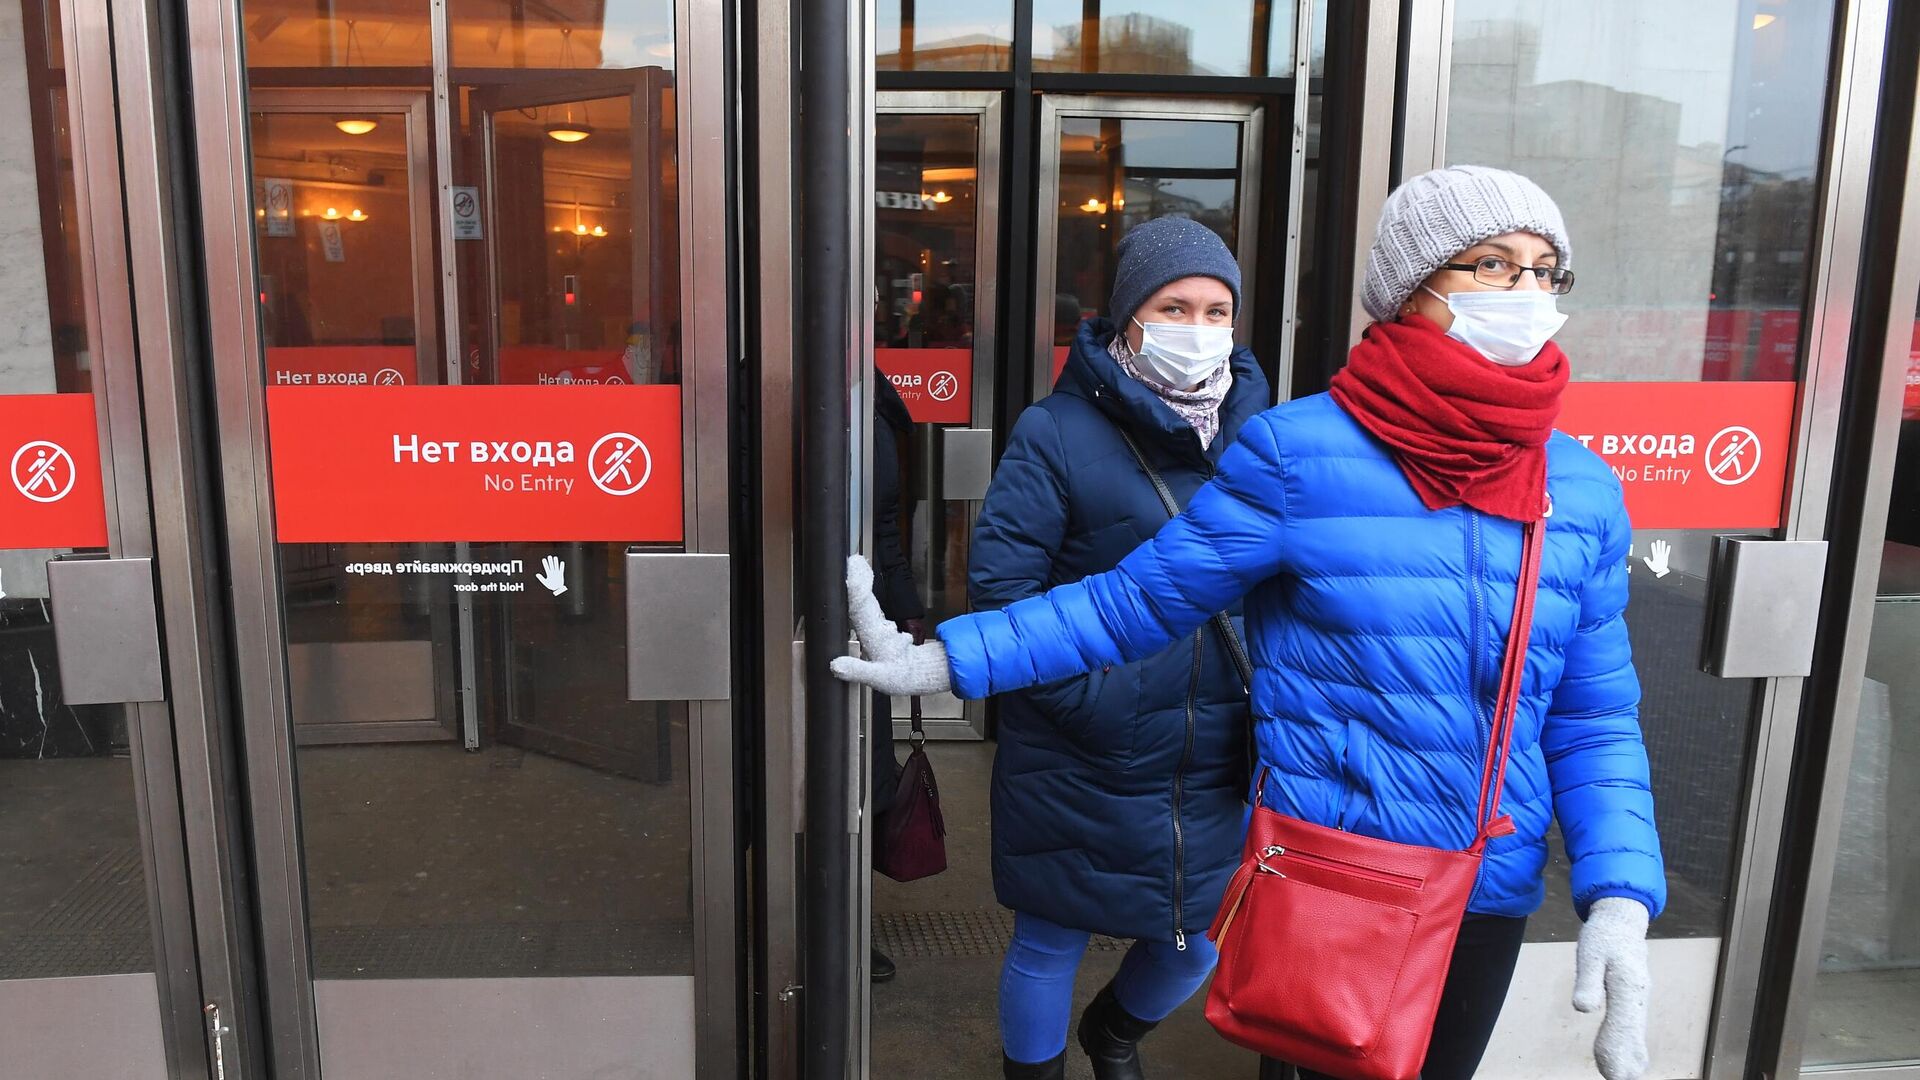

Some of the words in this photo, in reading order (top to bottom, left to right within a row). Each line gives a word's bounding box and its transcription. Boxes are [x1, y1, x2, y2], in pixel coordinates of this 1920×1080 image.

[276, 370, 312, 385] Нет
[317, 372, 367, 386] входа
[885, 374, 922, 387] ода
[392, 434, 460, 463] Нет
[470, 440, 575, 467] входа
[1602, 434, 1695, 459] входа
[484, 474, 514, 491] No
[521, 474, 574, 495] Entry
[1611, 465, 1638, 482] No
[1643, 465, 1691, 485] Entry
